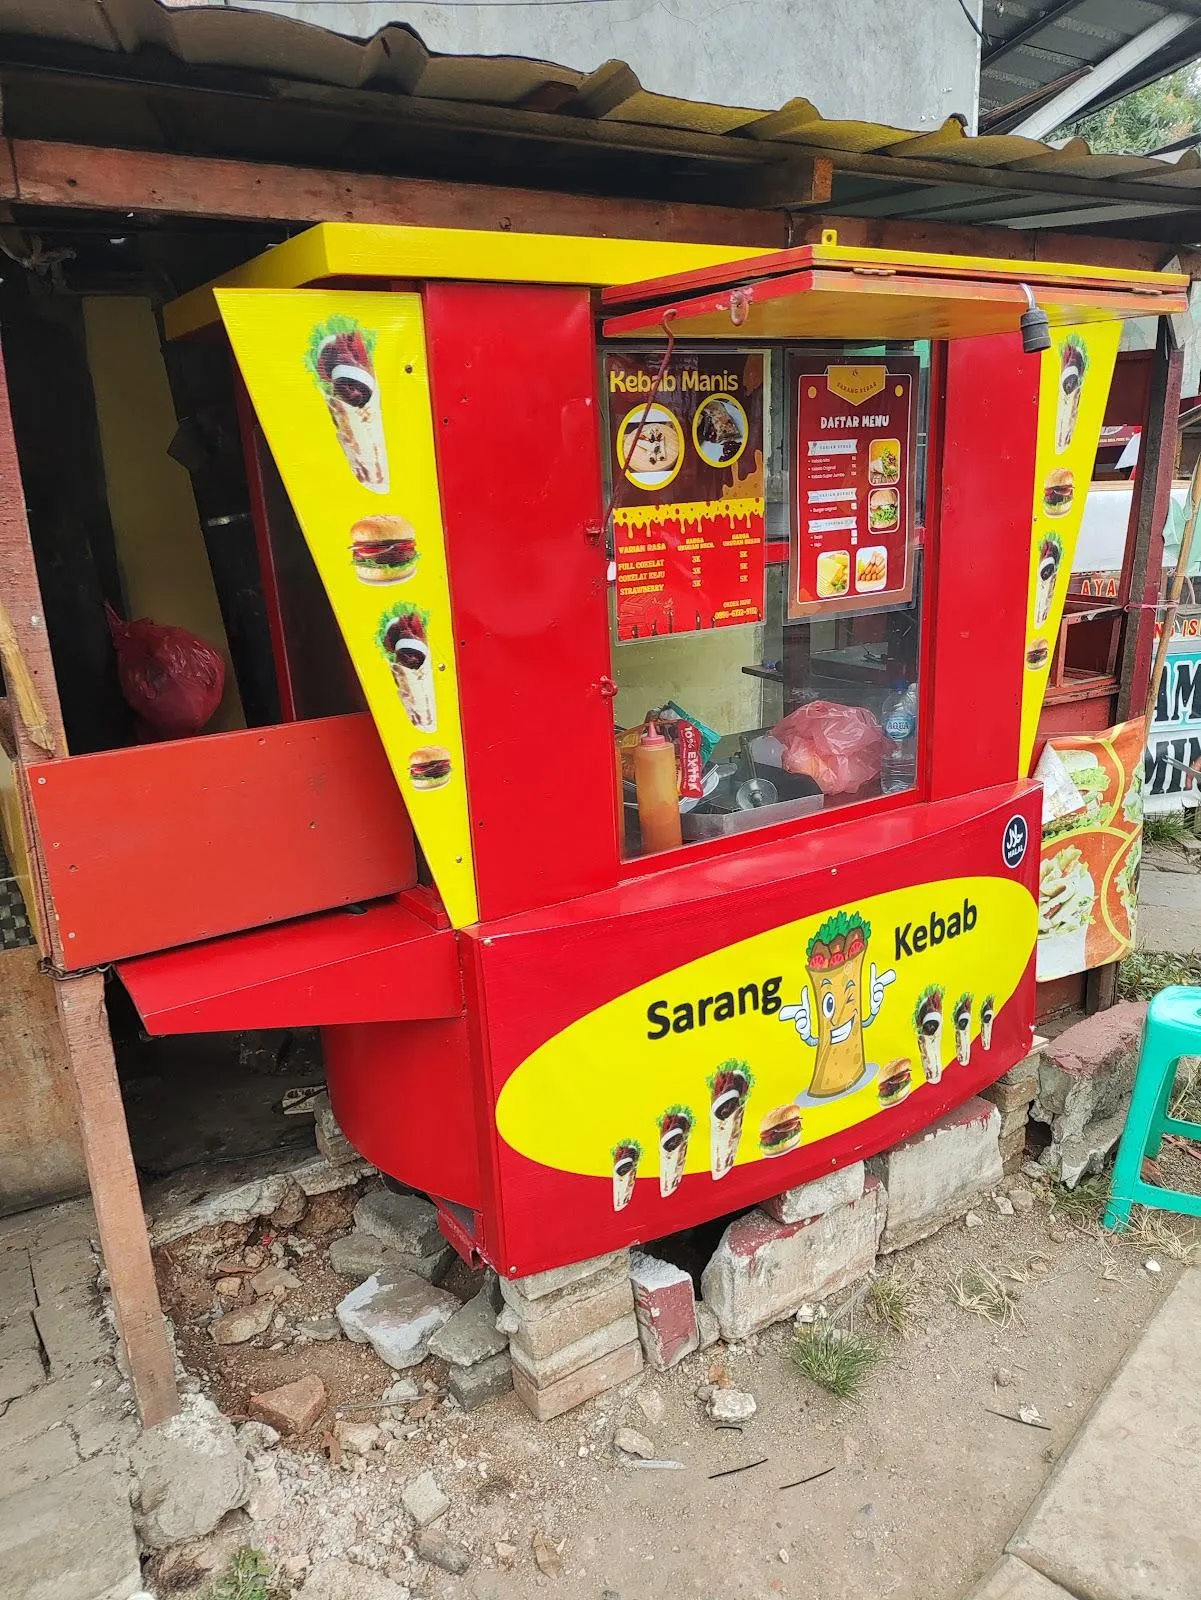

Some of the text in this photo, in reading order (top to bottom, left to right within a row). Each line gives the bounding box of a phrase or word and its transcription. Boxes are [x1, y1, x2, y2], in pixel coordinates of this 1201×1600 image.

[610, 370, 738, 393] Kebab Manis
[820, 414, 890, 429] DAFTAR MENU
[618, 559, 664, 571] FULL COKELAT
[618, 572, 648, 582] COKELAT
[620, 584, 664, 595] STRAWBERRY
[888, 721, 909, 731] AQUA
[684, 726, 694, 748] 10%
[688, 751, 701, 792] EXTRA
[1008, 845, 1024, 858] HALAL
[646, 898, 978, 1040] Sarang Kebab
